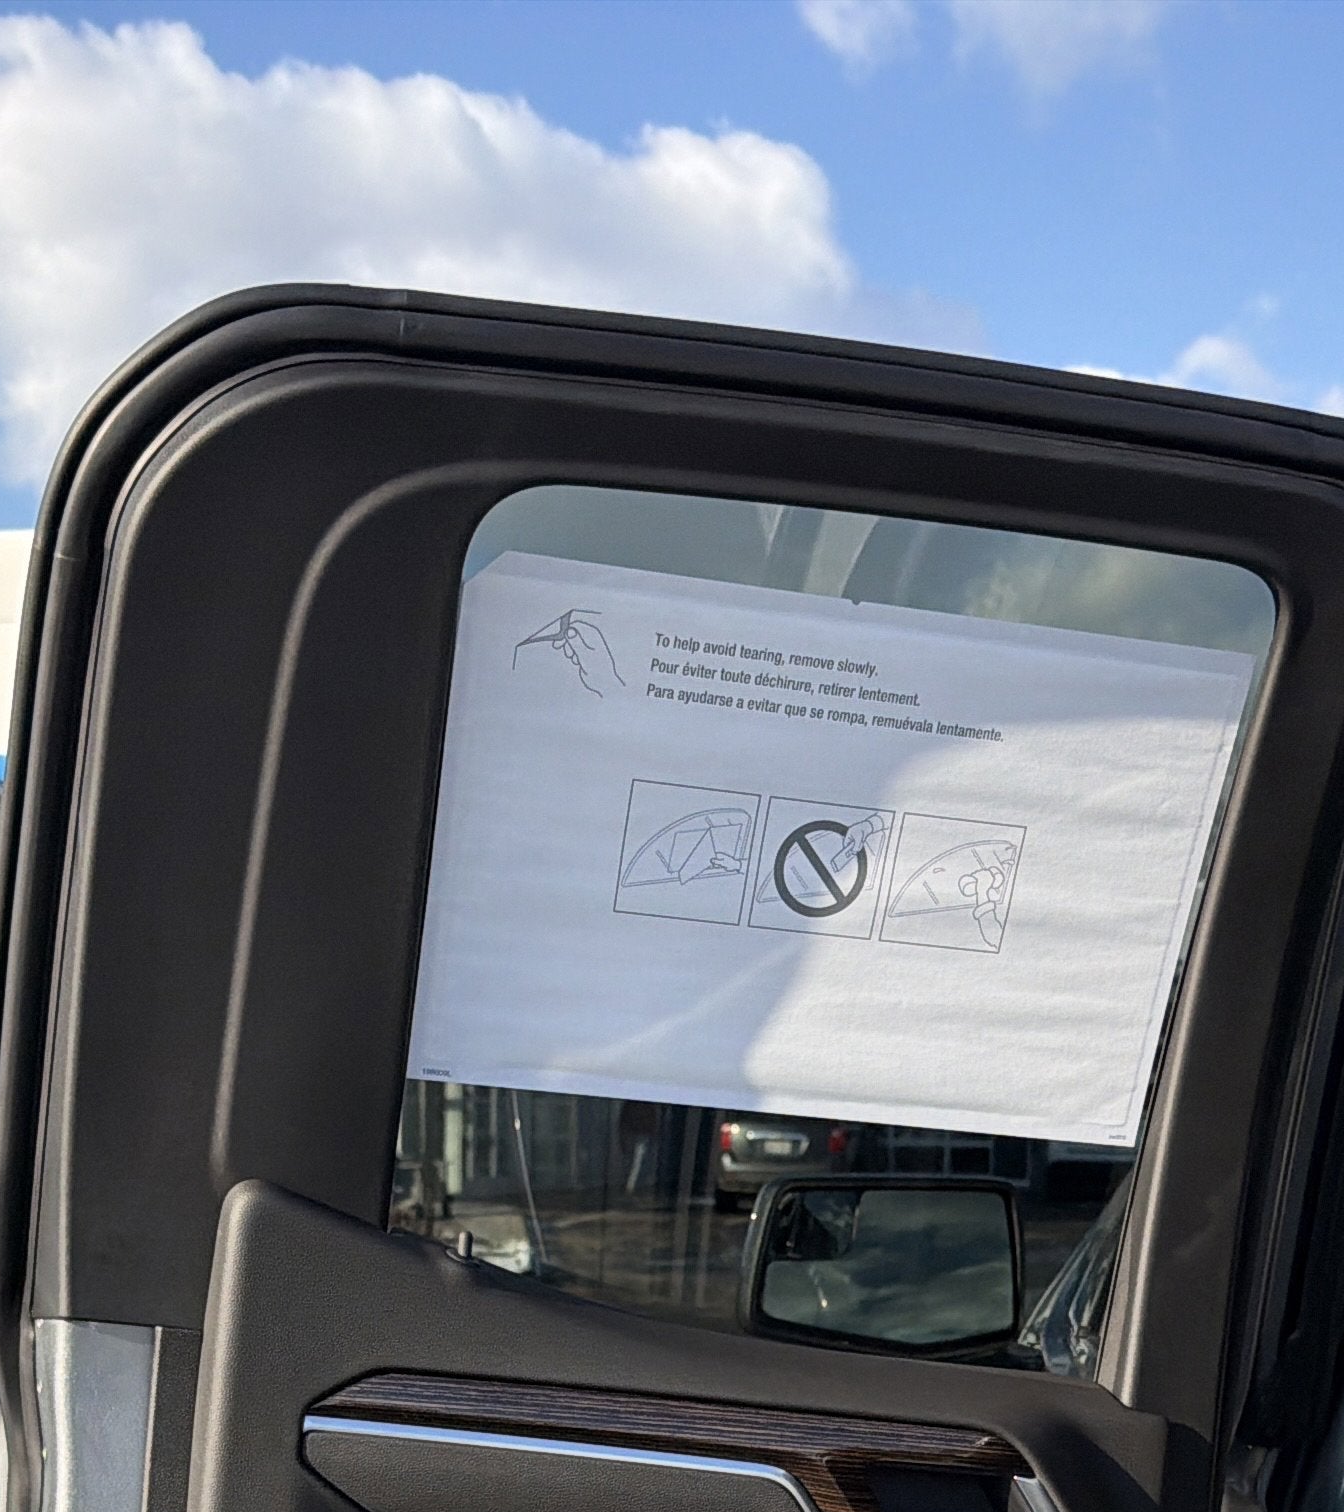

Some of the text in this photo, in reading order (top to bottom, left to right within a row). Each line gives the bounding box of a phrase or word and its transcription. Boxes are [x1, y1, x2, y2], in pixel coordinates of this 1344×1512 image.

[656, 632, 879, 678] To help avoid tearing, remove slowly.
[650, 658, 920, 707] Pour éviter toute déchirure, retirer lentement.
[647, 683, 1004, 742] Para ayudarse a evitar que se rompa, remuévala lentamente.
